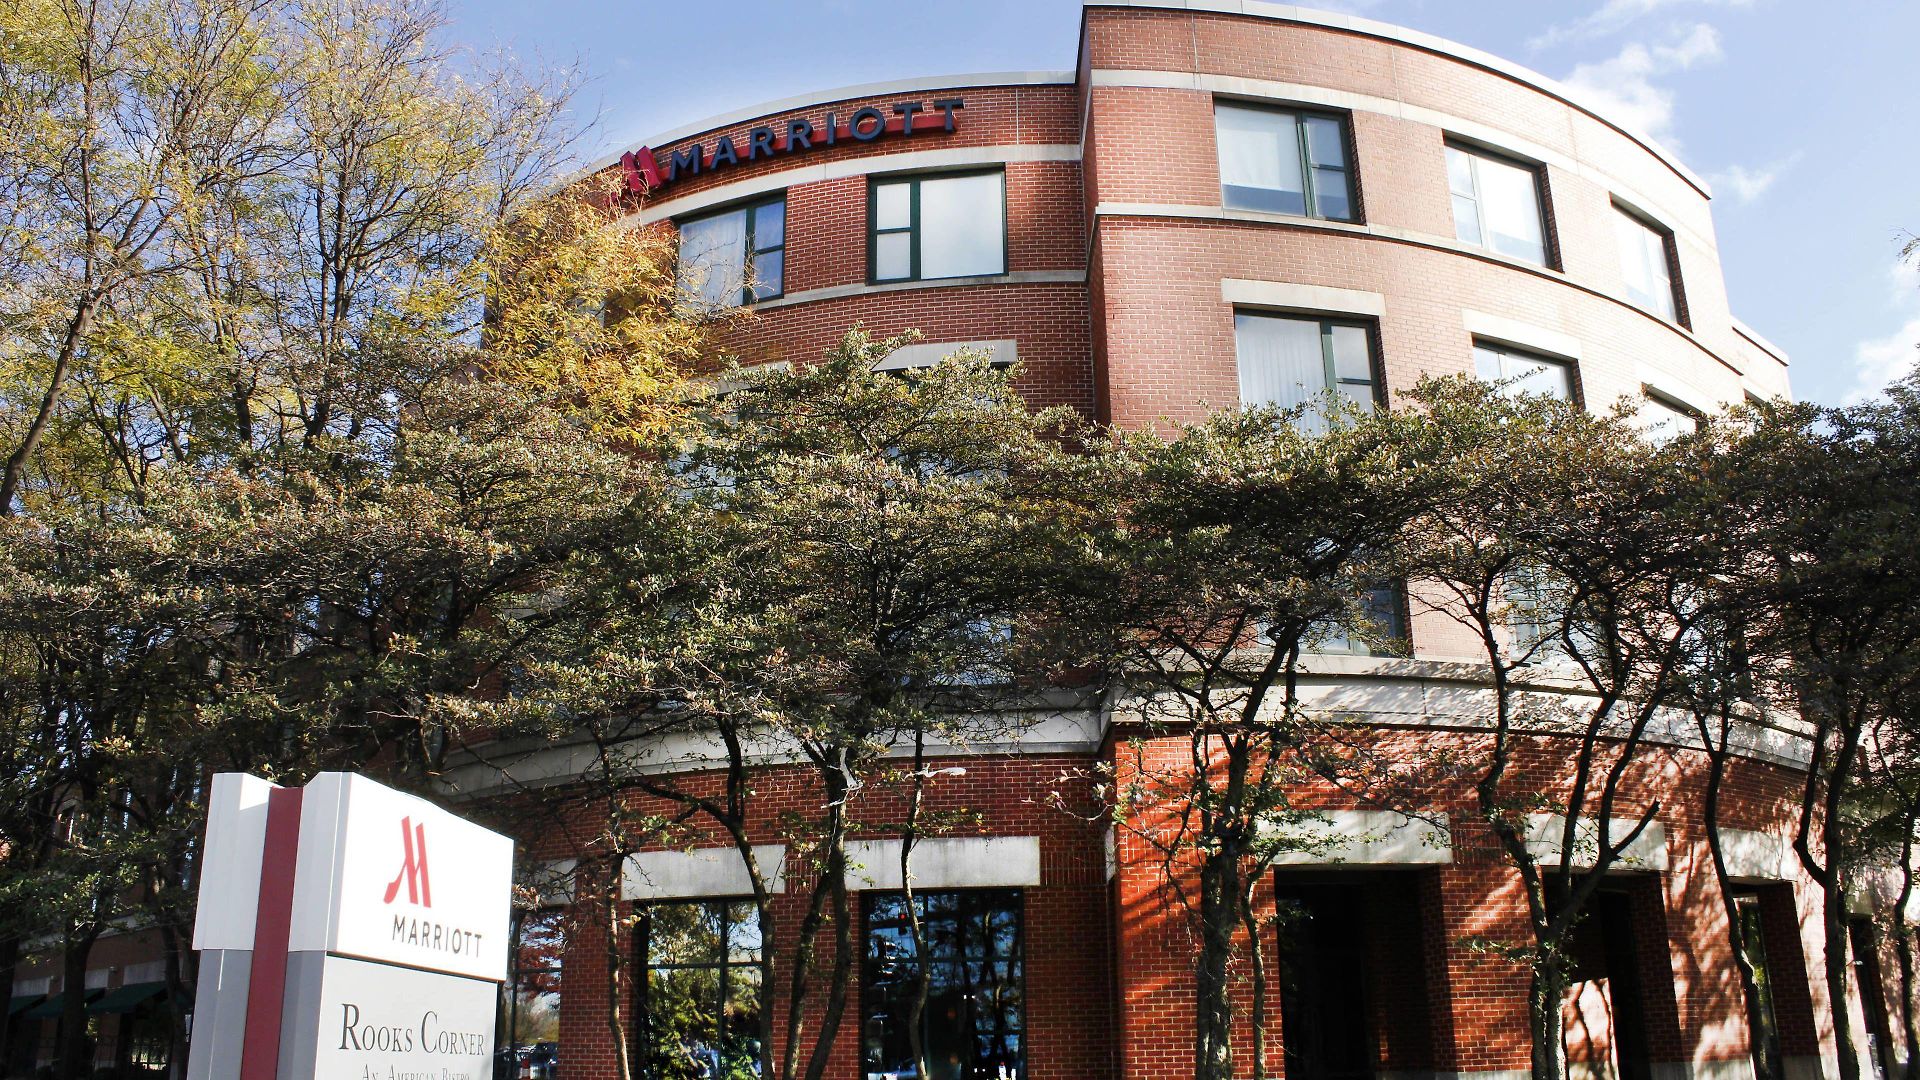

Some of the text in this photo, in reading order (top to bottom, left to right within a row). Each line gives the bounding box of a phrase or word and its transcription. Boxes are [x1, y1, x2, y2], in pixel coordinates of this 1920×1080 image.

[668, 99, 965, 182] MARRIOTT
[392, 914, 482, 958] MARRIOTT
[338, 1003, 485, 1056] ROOKS CORNER
